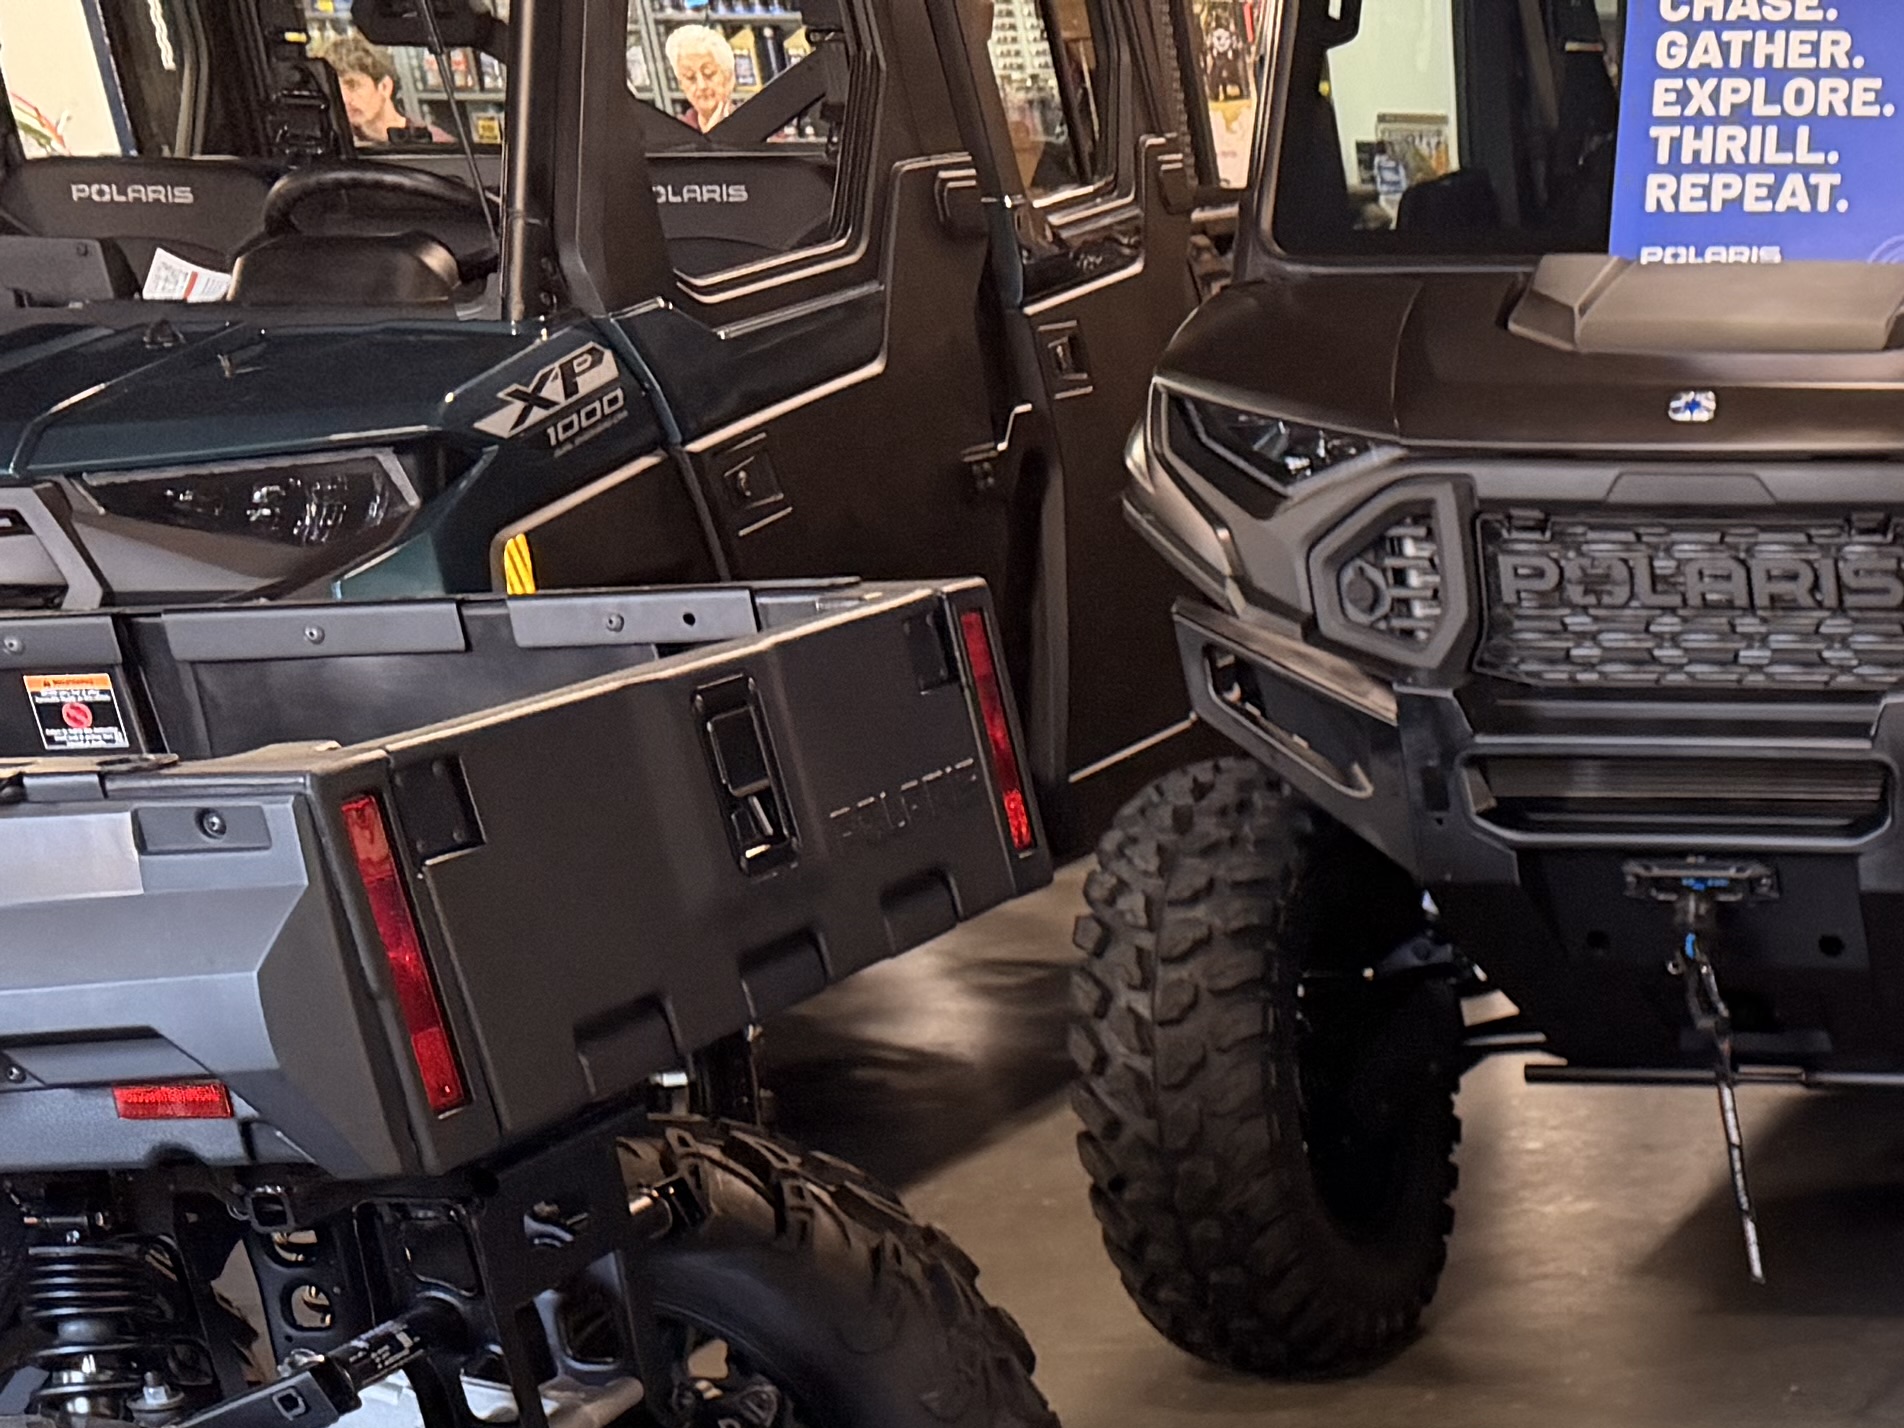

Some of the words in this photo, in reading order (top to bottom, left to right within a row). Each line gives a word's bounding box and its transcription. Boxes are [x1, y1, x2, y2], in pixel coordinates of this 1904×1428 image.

[1659, 0, 1838, 21] CHASE.
[1655, 30, 1864, 69] GATHER.
[1652, 77, 1895, 117] EXPLORE.
[1649, 125, 1839, 164] THRILL.
[71, 183, 194, 204] POLARIS
[652, 184, 748, 203] OLARIS
[1645, 173, 1848, 213] REPEAT.
[1640, 246, 1782, 265] POLARIS
[506, 347, 605, 432] XP
[547, 388, 624, 447] 1000
